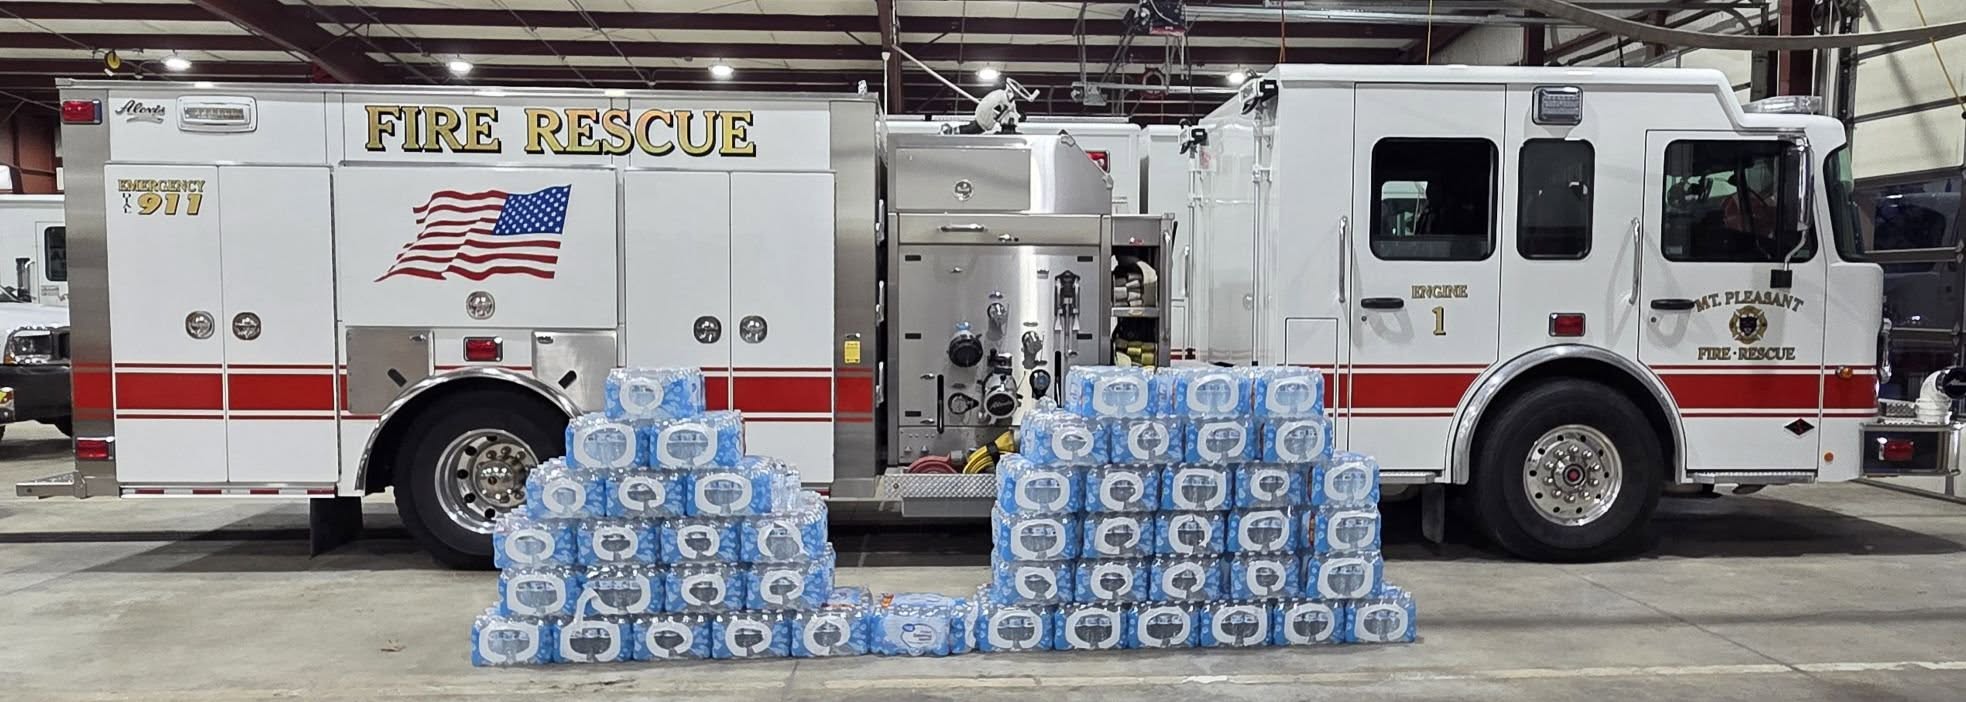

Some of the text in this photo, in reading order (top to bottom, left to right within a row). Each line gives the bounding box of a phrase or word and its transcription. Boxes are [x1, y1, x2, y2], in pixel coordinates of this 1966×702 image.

[365, 105, 757, 157] FIRE RESCUE
[118, 179, 205, 192] EMERGENCY
[137, 193, 202, 215] 911
[1411, 284, 1468, 299] ENGINE
[1725, 290, 1804, 312] PLEASANT
[1432, 306, 1446, 336] 1
